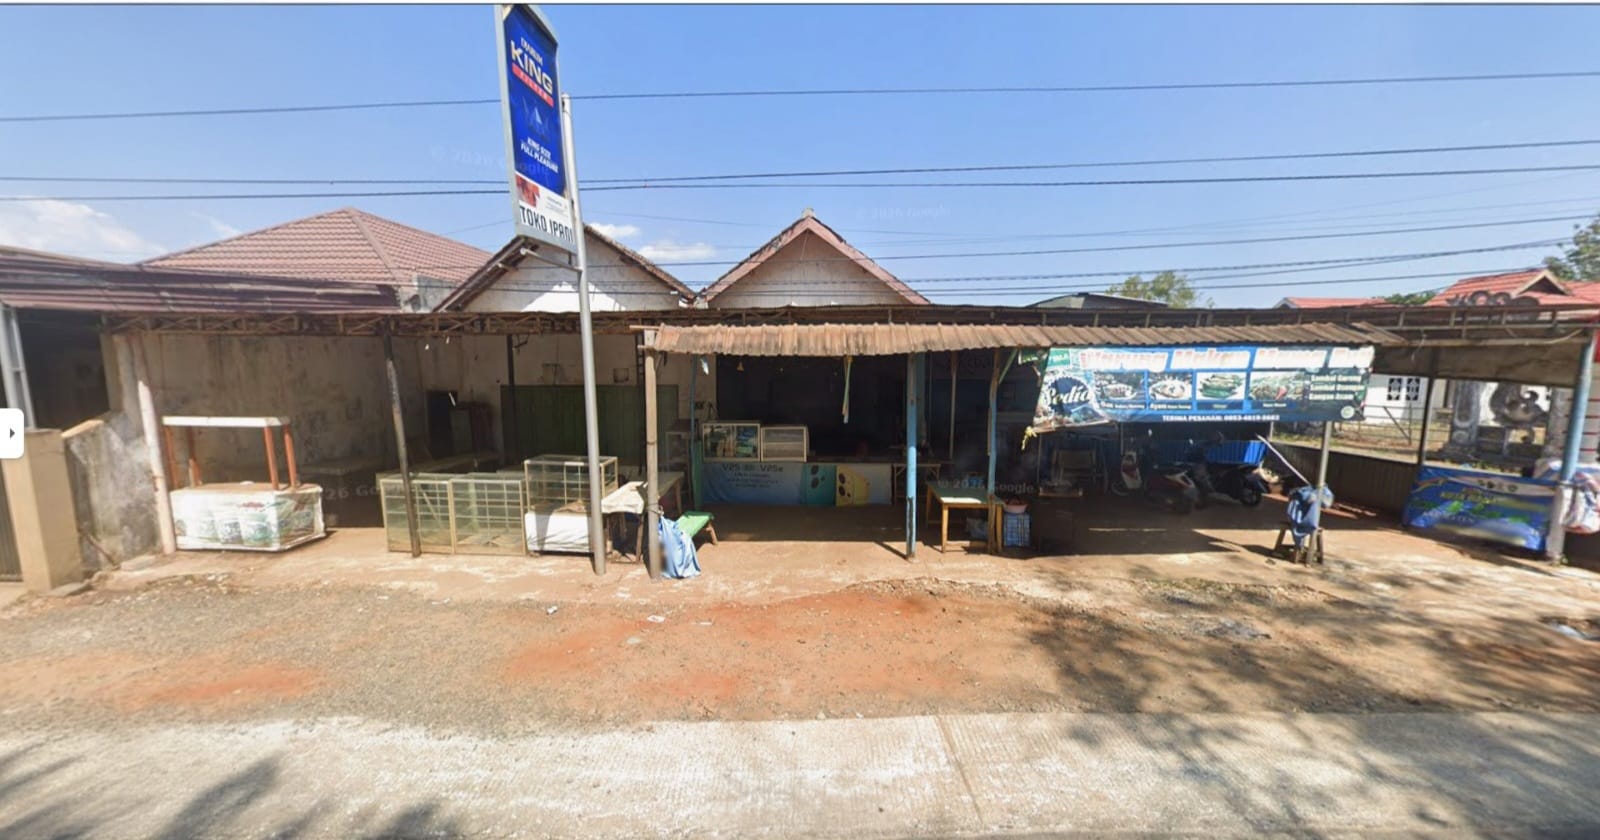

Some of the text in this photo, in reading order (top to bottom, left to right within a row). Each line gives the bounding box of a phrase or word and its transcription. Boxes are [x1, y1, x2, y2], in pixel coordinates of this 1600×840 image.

[510, 39, 553, 95] KING
[520, 141, 534, 158] FULL
[519, 205, 548, 232] TOKO
